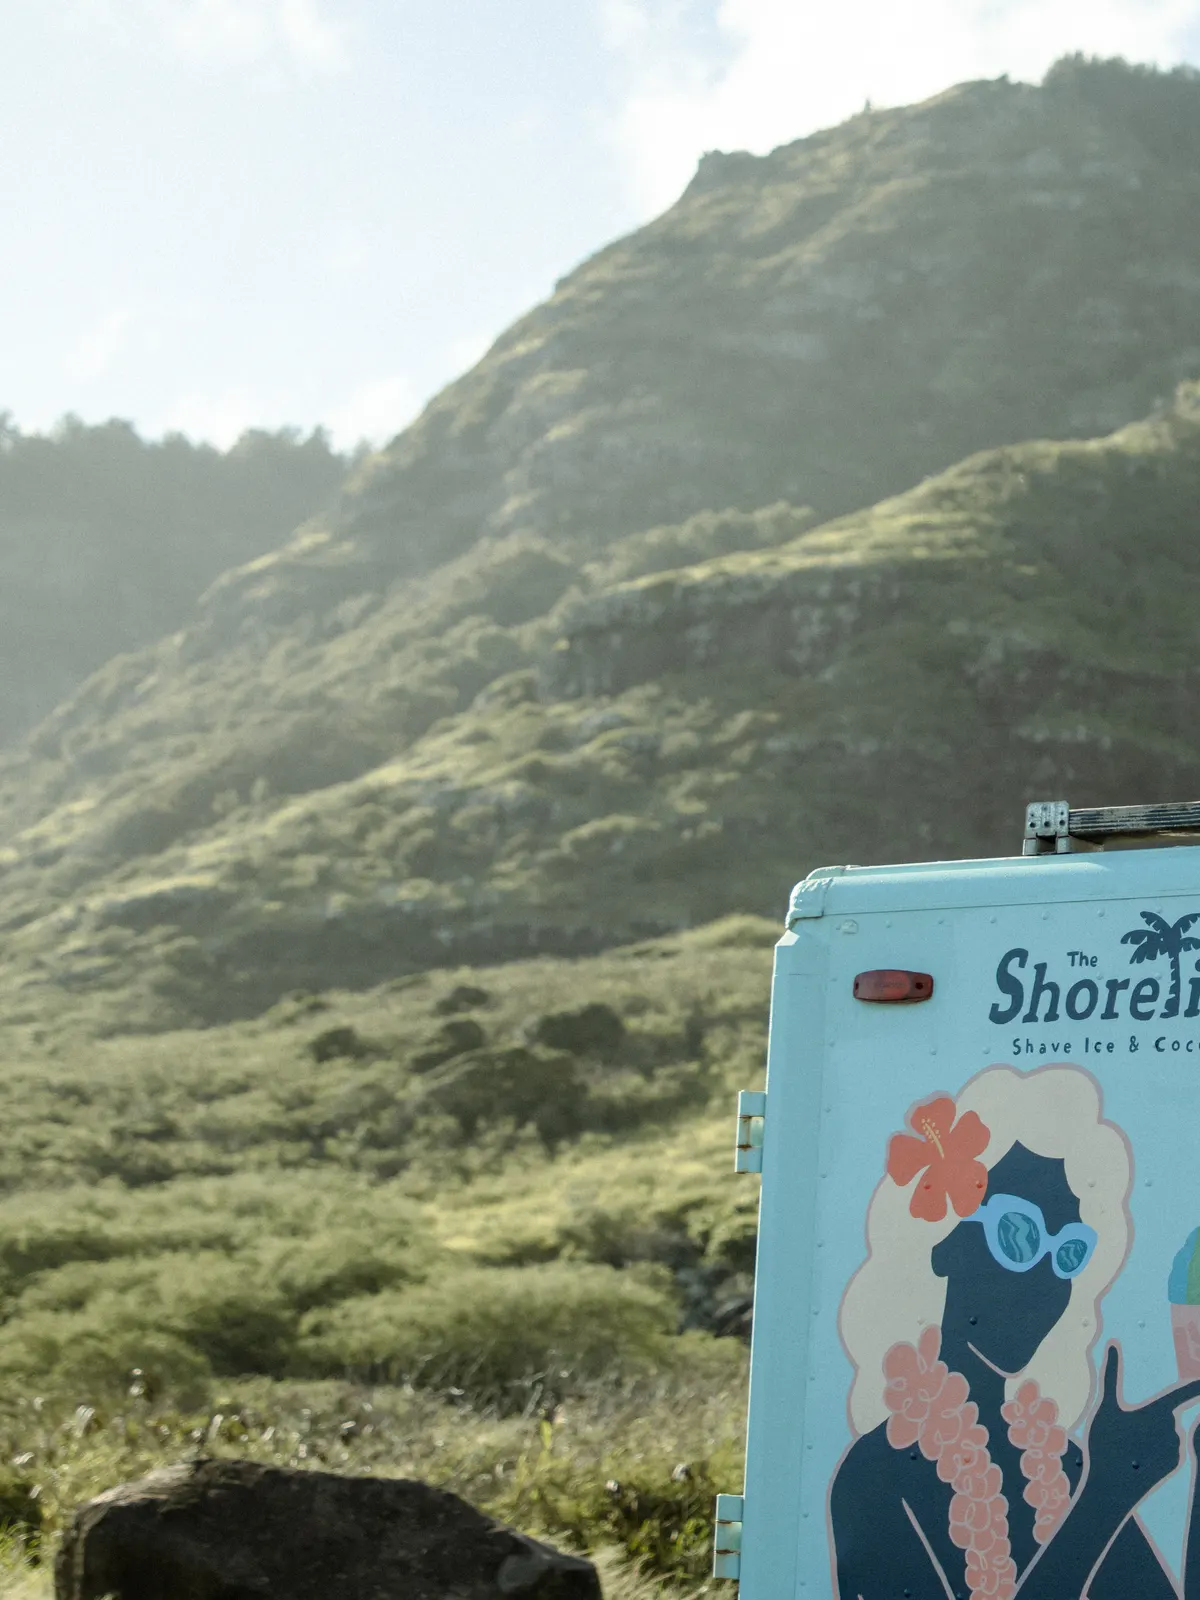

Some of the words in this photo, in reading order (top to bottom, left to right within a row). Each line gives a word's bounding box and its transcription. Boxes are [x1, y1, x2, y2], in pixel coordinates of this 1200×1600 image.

[1067, 951, 1099, 968] The
[1012, 1037, 1072, 1056] Shave
[1085, 1037, 1115, 1054] Ice
[1129, 1035, 1140, 1053] &
